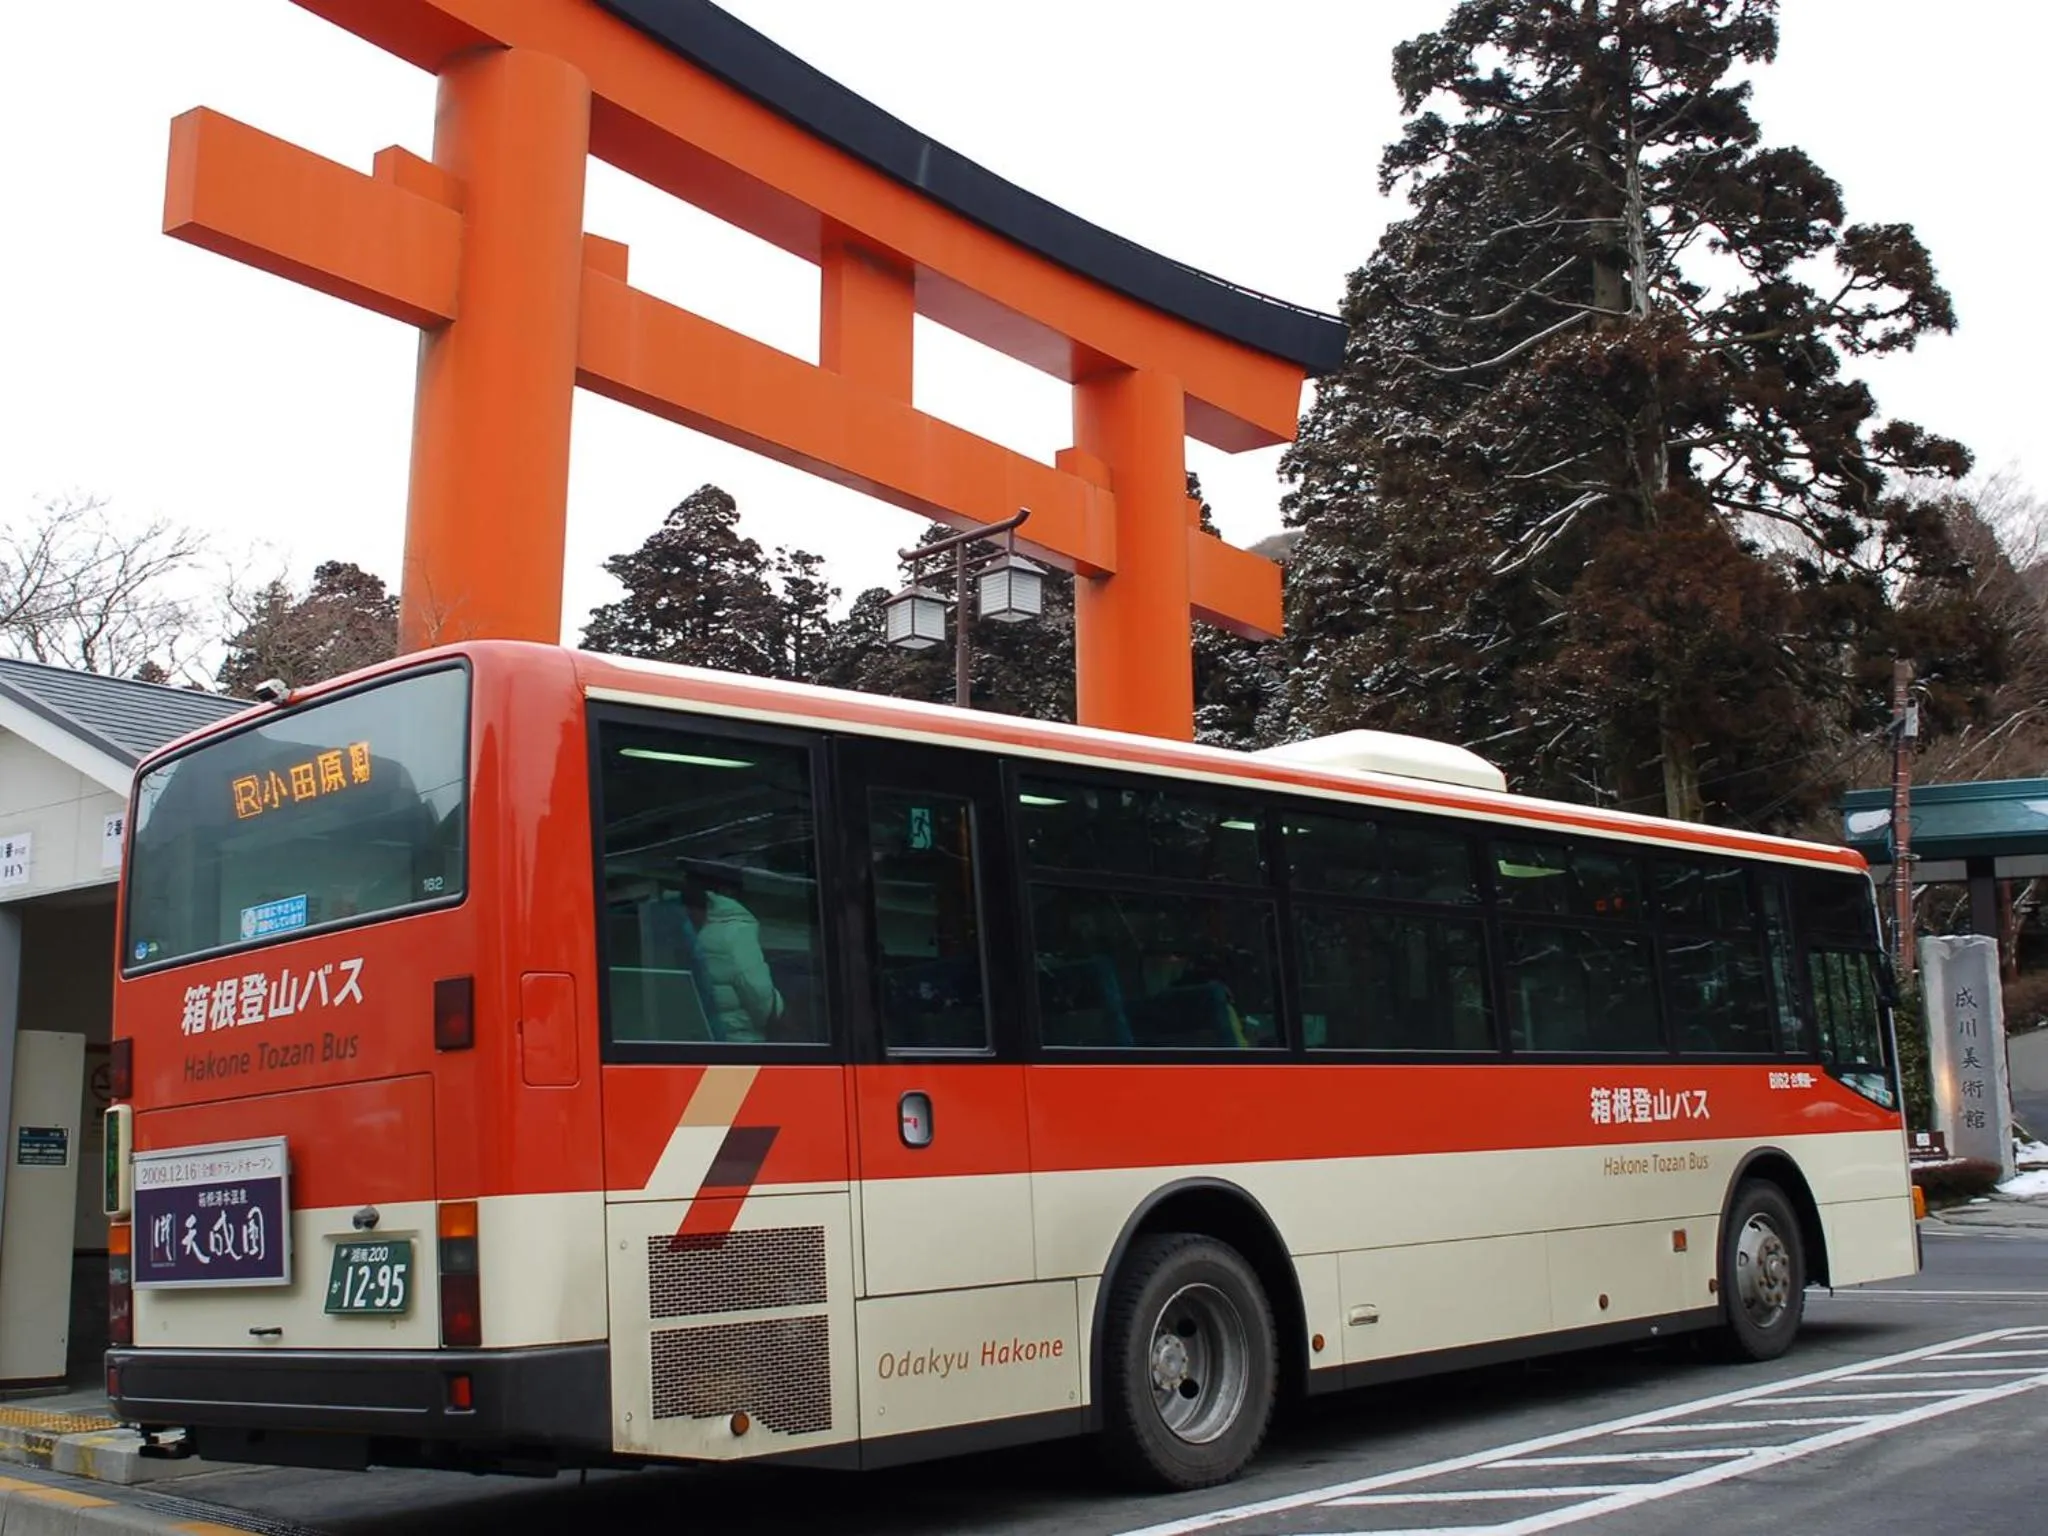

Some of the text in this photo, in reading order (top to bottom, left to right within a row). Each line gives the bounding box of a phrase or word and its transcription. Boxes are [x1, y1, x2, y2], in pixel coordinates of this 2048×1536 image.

[423, 877, 444, 891] 162
[181, 957, 364, 1036] 箱根登山バス
[184, 1032, 359, 1083] Hakone Tozan Bus
[1955, 987, 1986, 1129] 成川美術館
[1591, 1087, 1710, 1125] 箱根登山バス
[1604, 1151, 1709, 1176] Hakone Tozan Bus
[878, 1337, 1064, 1379] Odakyu Hakone
